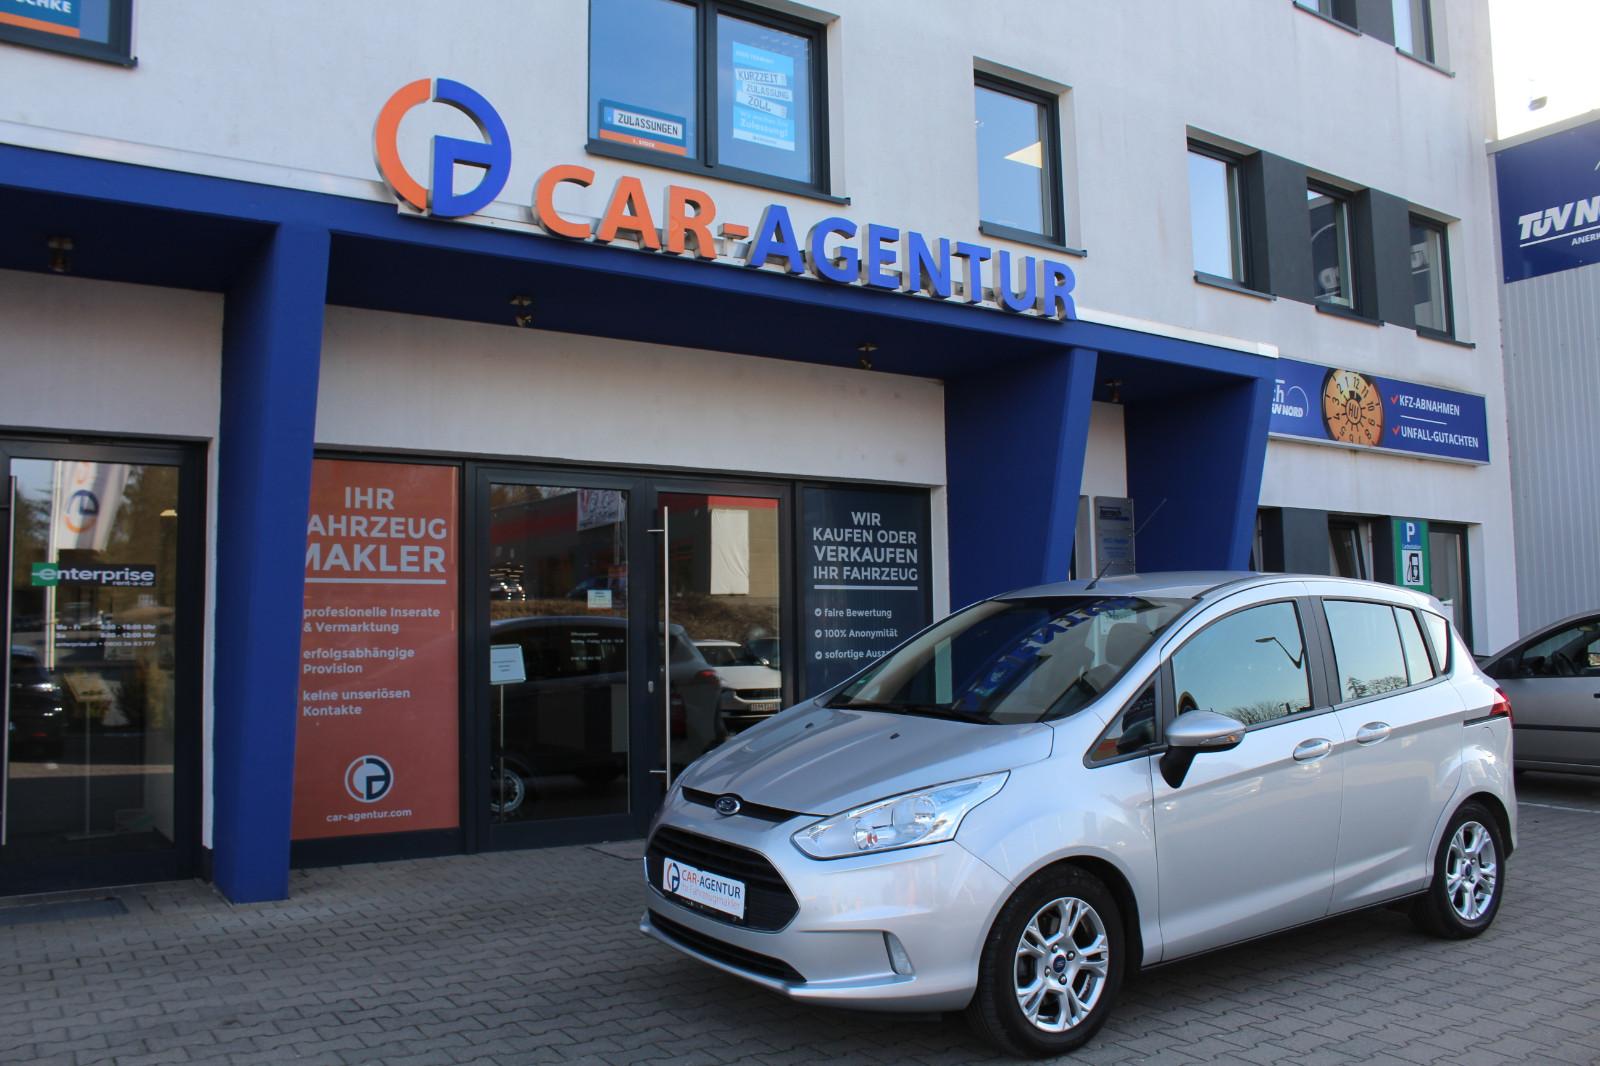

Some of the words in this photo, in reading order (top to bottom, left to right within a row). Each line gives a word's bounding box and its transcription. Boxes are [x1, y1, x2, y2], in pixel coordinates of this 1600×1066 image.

[738, 70, 778, 84] KURZZEIT
[746, 83, 790, 99] ZULASSUNG
[748, 95, 772, 112] ZOLL
[617, 113, 678, 136] ZULASSUNGEN
[1518, 202, 1575, 240] TÜV
[532, 164, 1077, 321] CAR-AGENTUR
[1282, 404, 1304, 418] NORD
[1399, 394, 1460, 416] KFZ-ABNAHMEN
[1401, 425, 1479, 448] UNFALL-GUTACHTEN
[345, 486, 395, 510] IHR
[851, 511, 881, 526] WIR
[307, 514, 447, 540] AHRZEUG
[1406, 522, 1415, 543] P
[813, 527, 873, 543] KAUFEN
[877, 530, 917, 544] ODER
[813, 545, 918, 564] VERKAUFEN
[38, 567, 154, 583] enterprise
[813, 566, 839, 580] IHR
[843, 567, 918, 581] FAHRZEUG
[390, 607, 441, 617] Inserate
[824, 608, 844, 617] faire
[846, 609, 892, 619] Bewertung
[303, 622, 312, 633] &
[315, 622, 400, 634] Vermarktung
[824, 629, 847, 638] 100%
[849, 629, 898, 640] Anonymität
[303, 647, 416, 661] erfolgsabhängige
[824, 650, 865, 661] sofortige
[303, 663, 363, 675] Provision
[303, 690, 339, 701] keine
[342, 688, 411, 699] unseriösen
[303, 705, 363, 717] Kontakte
[326, 808, 412, 823] car-agentur.com
[681, 869, 741, 899] CAR-AGENTUR
